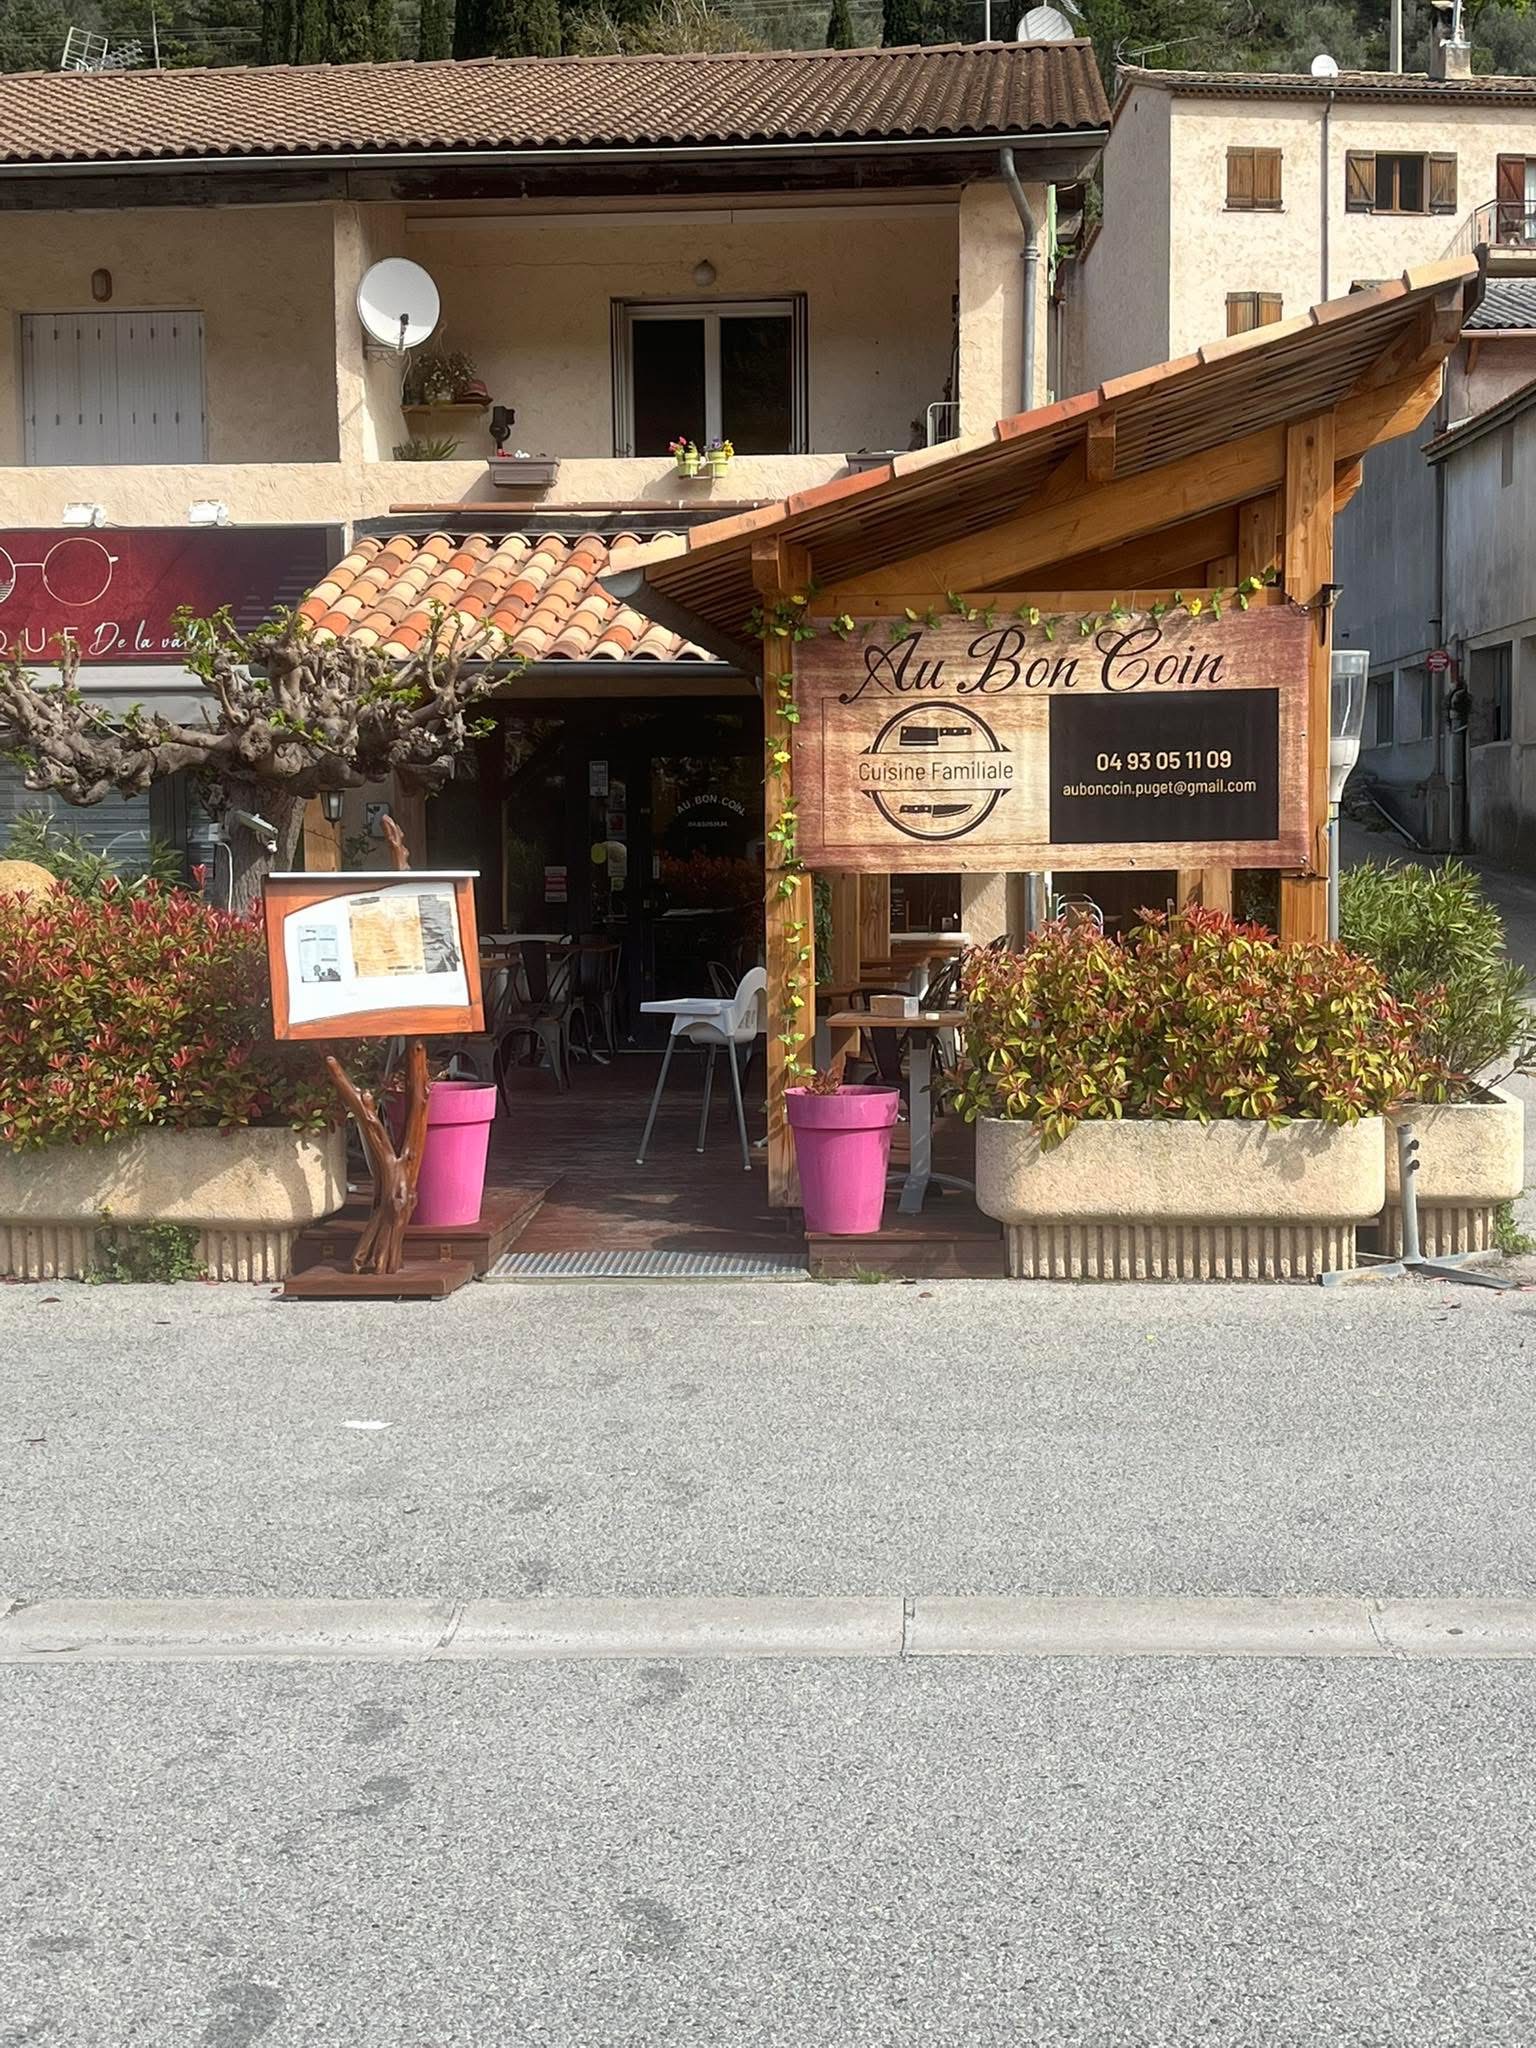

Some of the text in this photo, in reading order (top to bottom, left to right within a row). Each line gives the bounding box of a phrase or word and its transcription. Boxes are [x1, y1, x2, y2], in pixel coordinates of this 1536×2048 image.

[88, 622, 127, 655] De
[134, 619, 155, 651] la
[839, 624, 1225, 704] Au Bon Coin
[858, 761, 1014, 781] Cuisine Familiale
[1096, 750, 1232, 771] 04 93 05 11 09
[1063, 779, 1257, 798] auboncoin.puget@gmail.com
